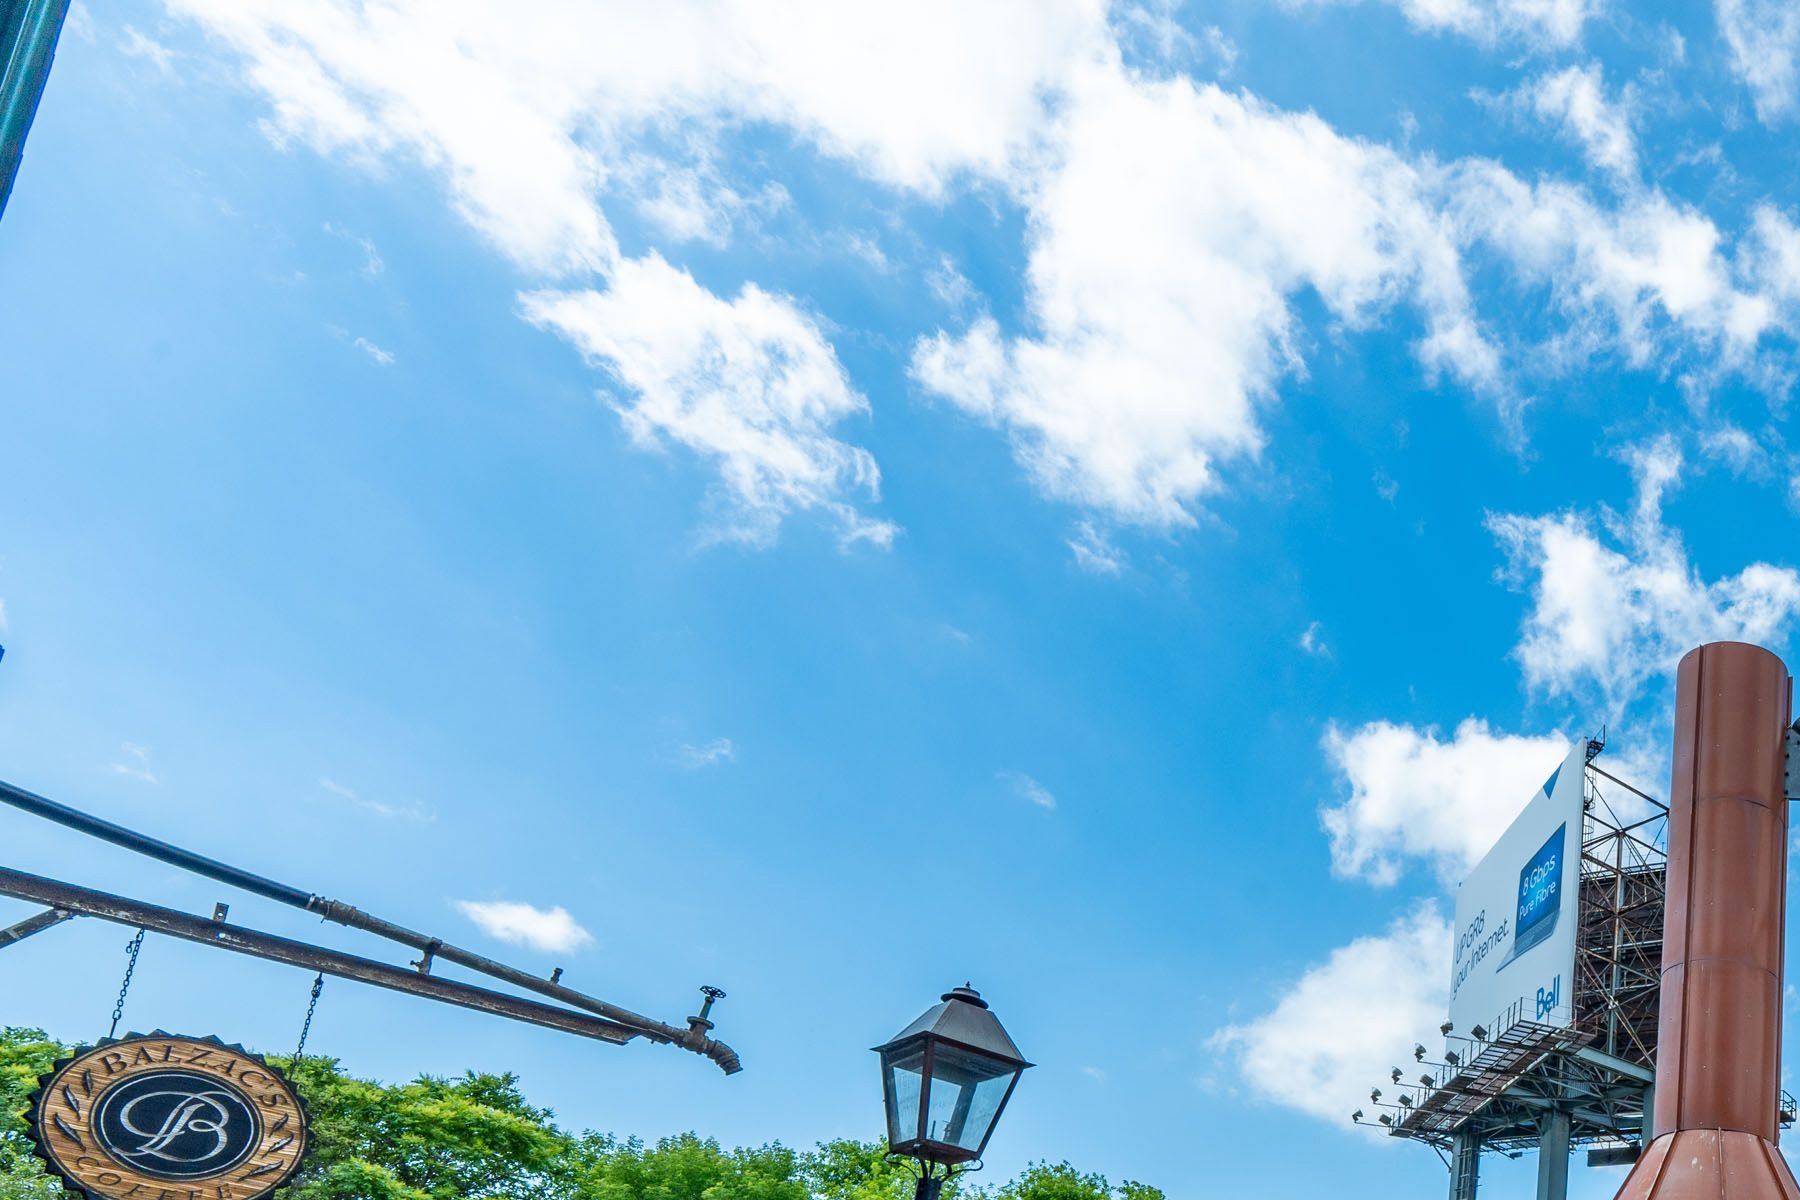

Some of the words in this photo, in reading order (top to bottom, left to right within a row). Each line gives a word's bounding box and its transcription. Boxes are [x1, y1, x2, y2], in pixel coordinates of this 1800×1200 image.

[1522, 877, 1530, 896] 8
[1529, 854, 1556, 888] Gbps
[1518, 900, 1534, 921] Pure
[1534, 881, 1556, 904] Fibre
[1455, 909, 1485, 964] UPGR8
[1453, 960, 1470, 1001] your
[1536, 974, 1560, 1020] Bell
